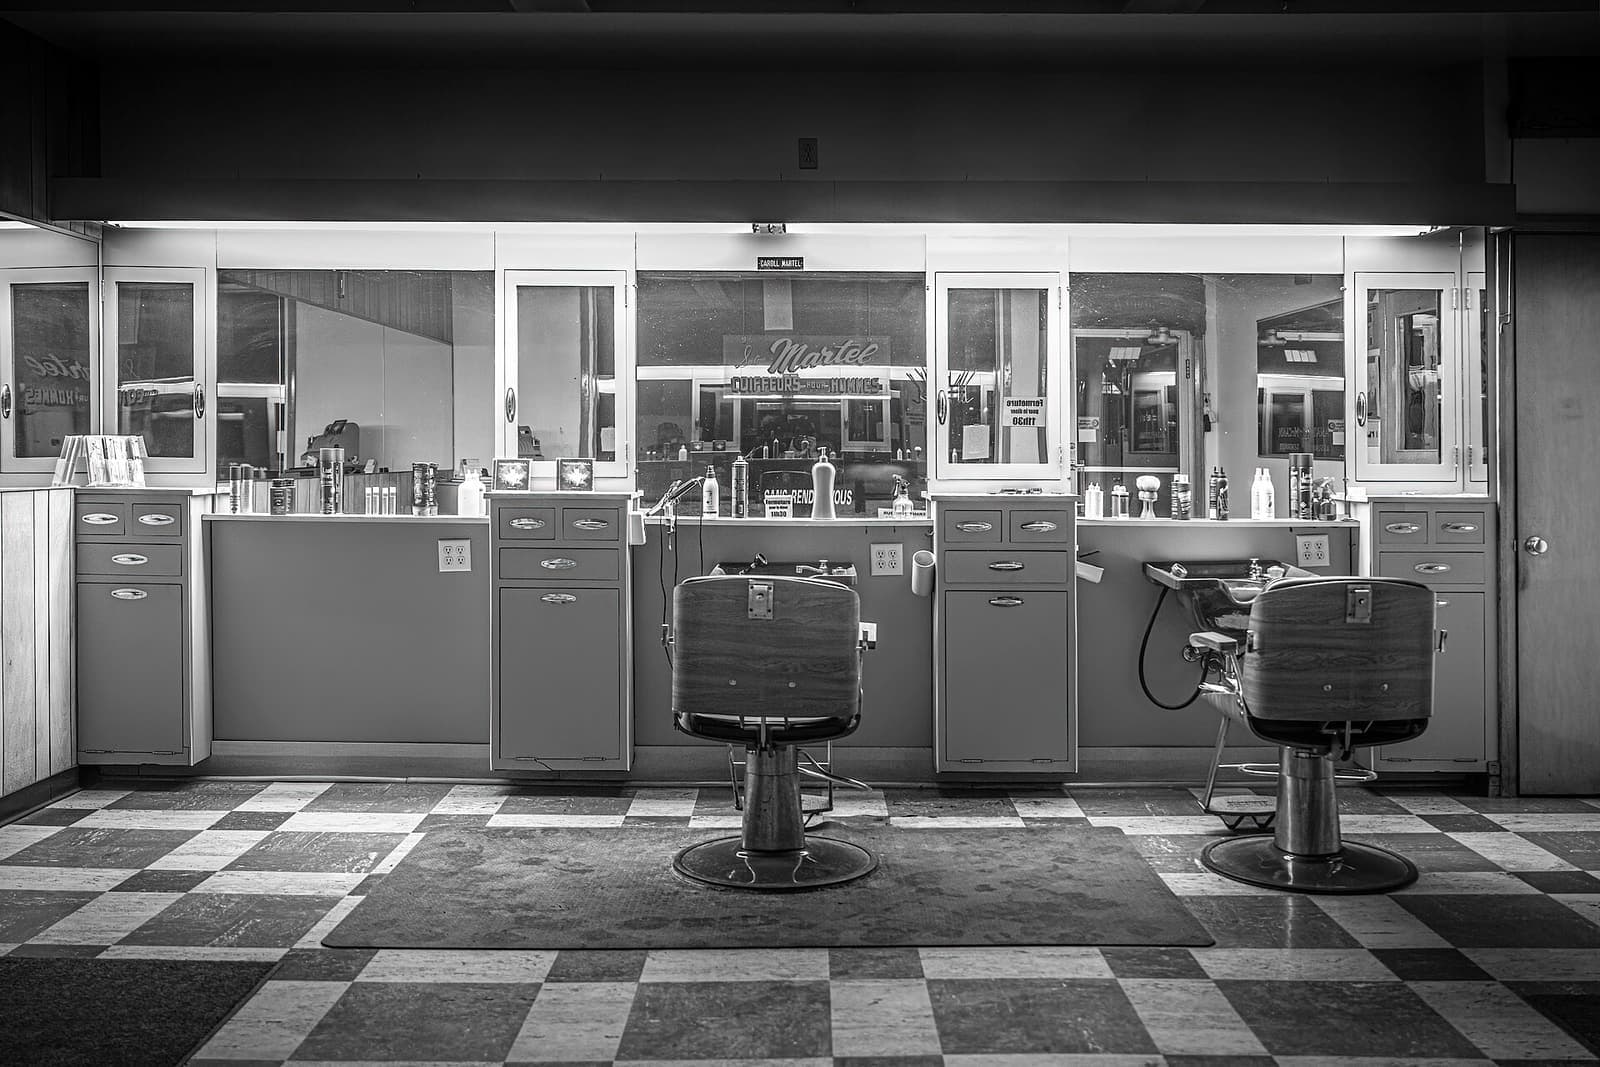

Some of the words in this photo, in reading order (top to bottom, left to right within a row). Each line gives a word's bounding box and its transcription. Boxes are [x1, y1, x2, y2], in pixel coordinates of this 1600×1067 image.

[781, 259, 801, 268] MARTEL
[766, 337, 879, 375] Martel
[730, 376, 800, 393] COIFFEURS
[830, 377, 881, 393] HOMMES
